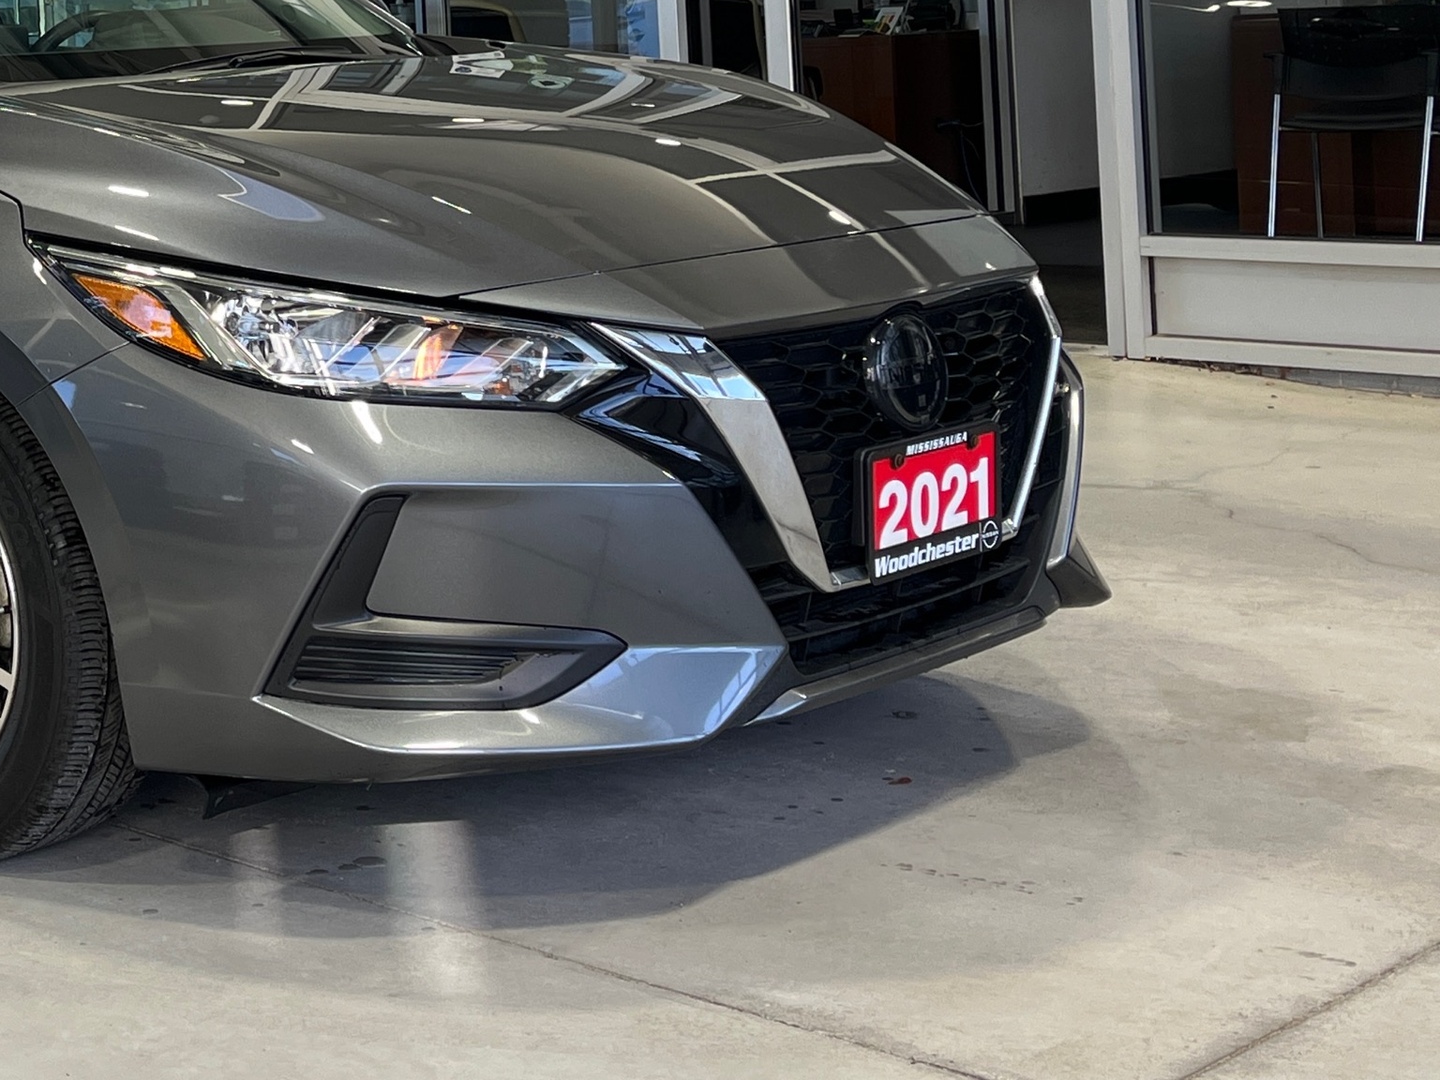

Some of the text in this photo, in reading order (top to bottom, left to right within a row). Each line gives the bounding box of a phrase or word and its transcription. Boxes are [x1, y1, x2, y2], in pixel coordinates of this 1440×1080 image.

[906, 431, 968, 456] MISSISSAUGA
[878, 456, 990, 550] 2021
[874, 532, 980, 578] Woodchester
